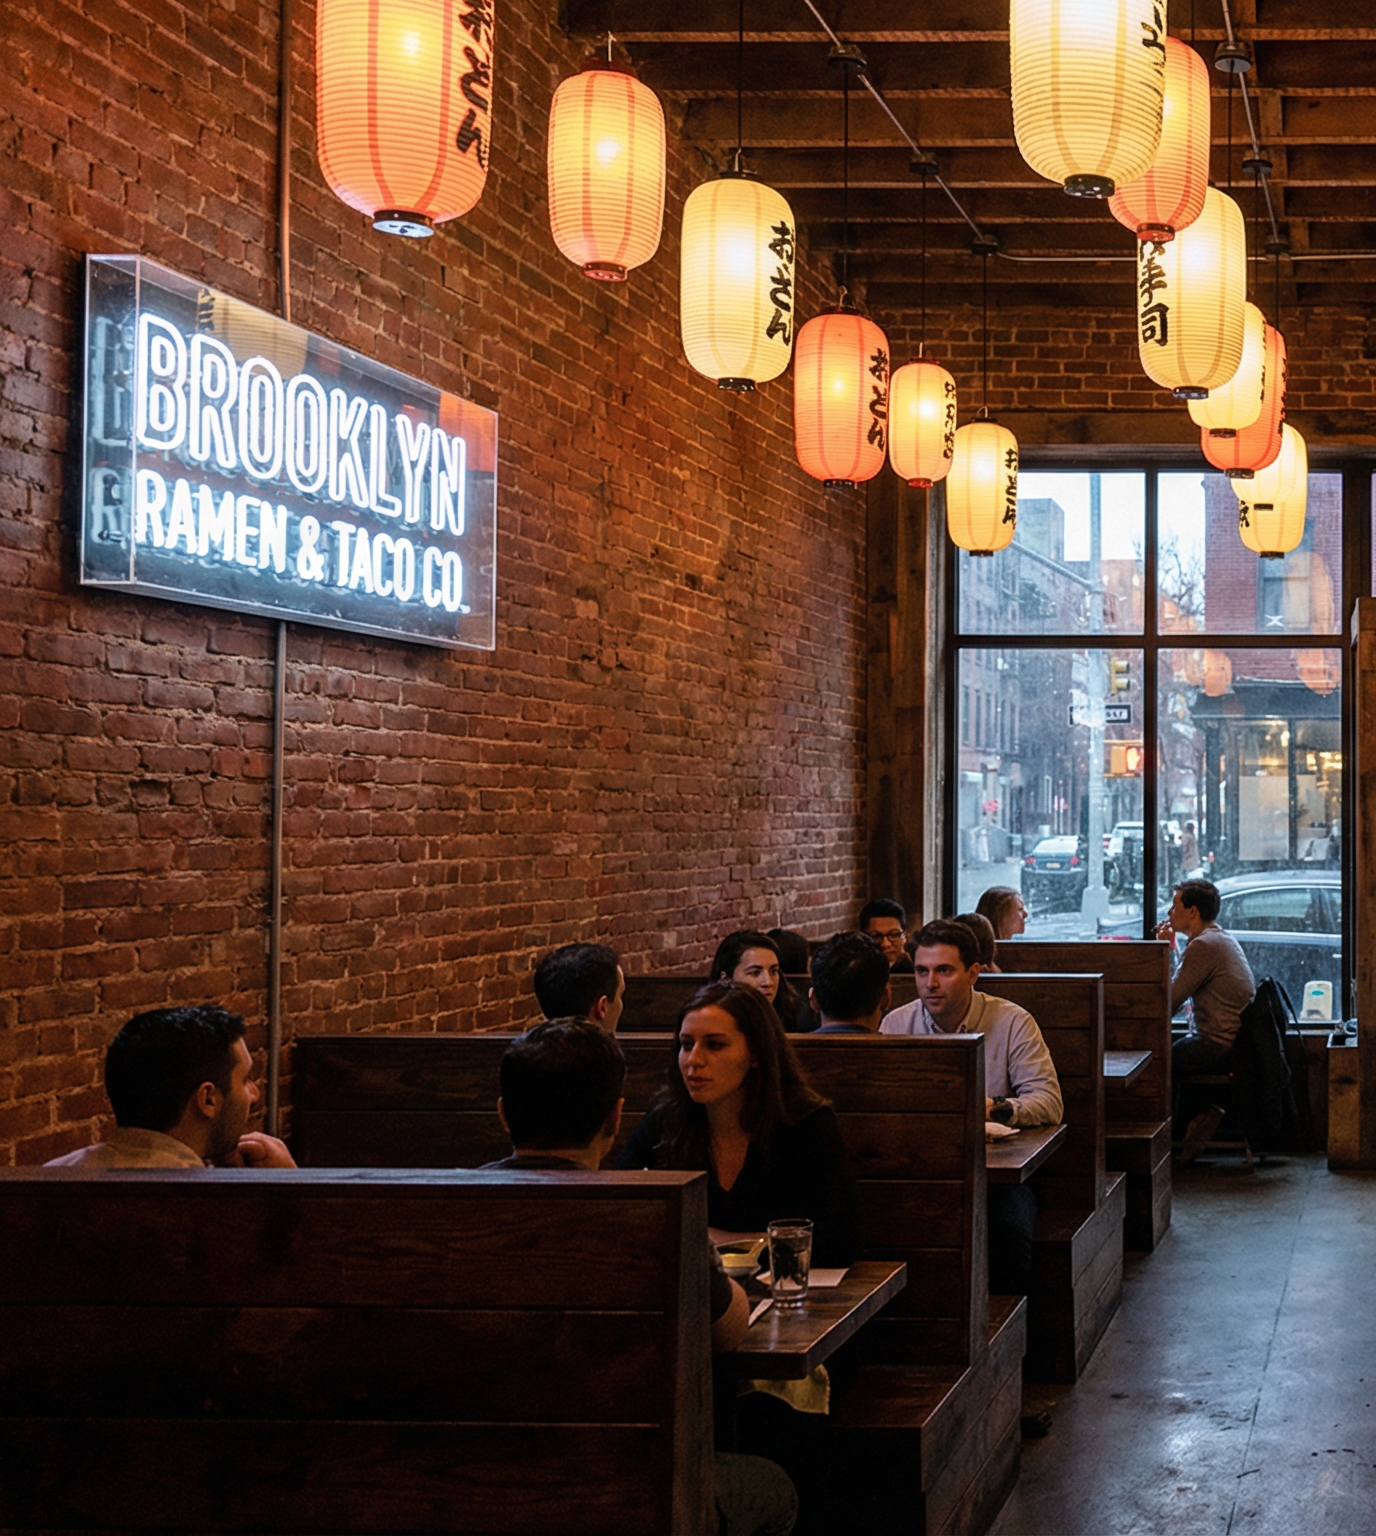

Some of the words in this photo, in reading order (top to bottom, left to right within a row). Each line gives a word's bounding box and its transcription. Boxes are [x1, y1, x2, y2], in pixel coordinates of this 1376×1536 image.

[138, 312, 467, 537] BROOKLYN
[135, 468, 288, 574] RAMEN
[296, 515, 325, 581] &
[331, 520, 416, 602] TACO
[422, 546, 471, 614] CO.
